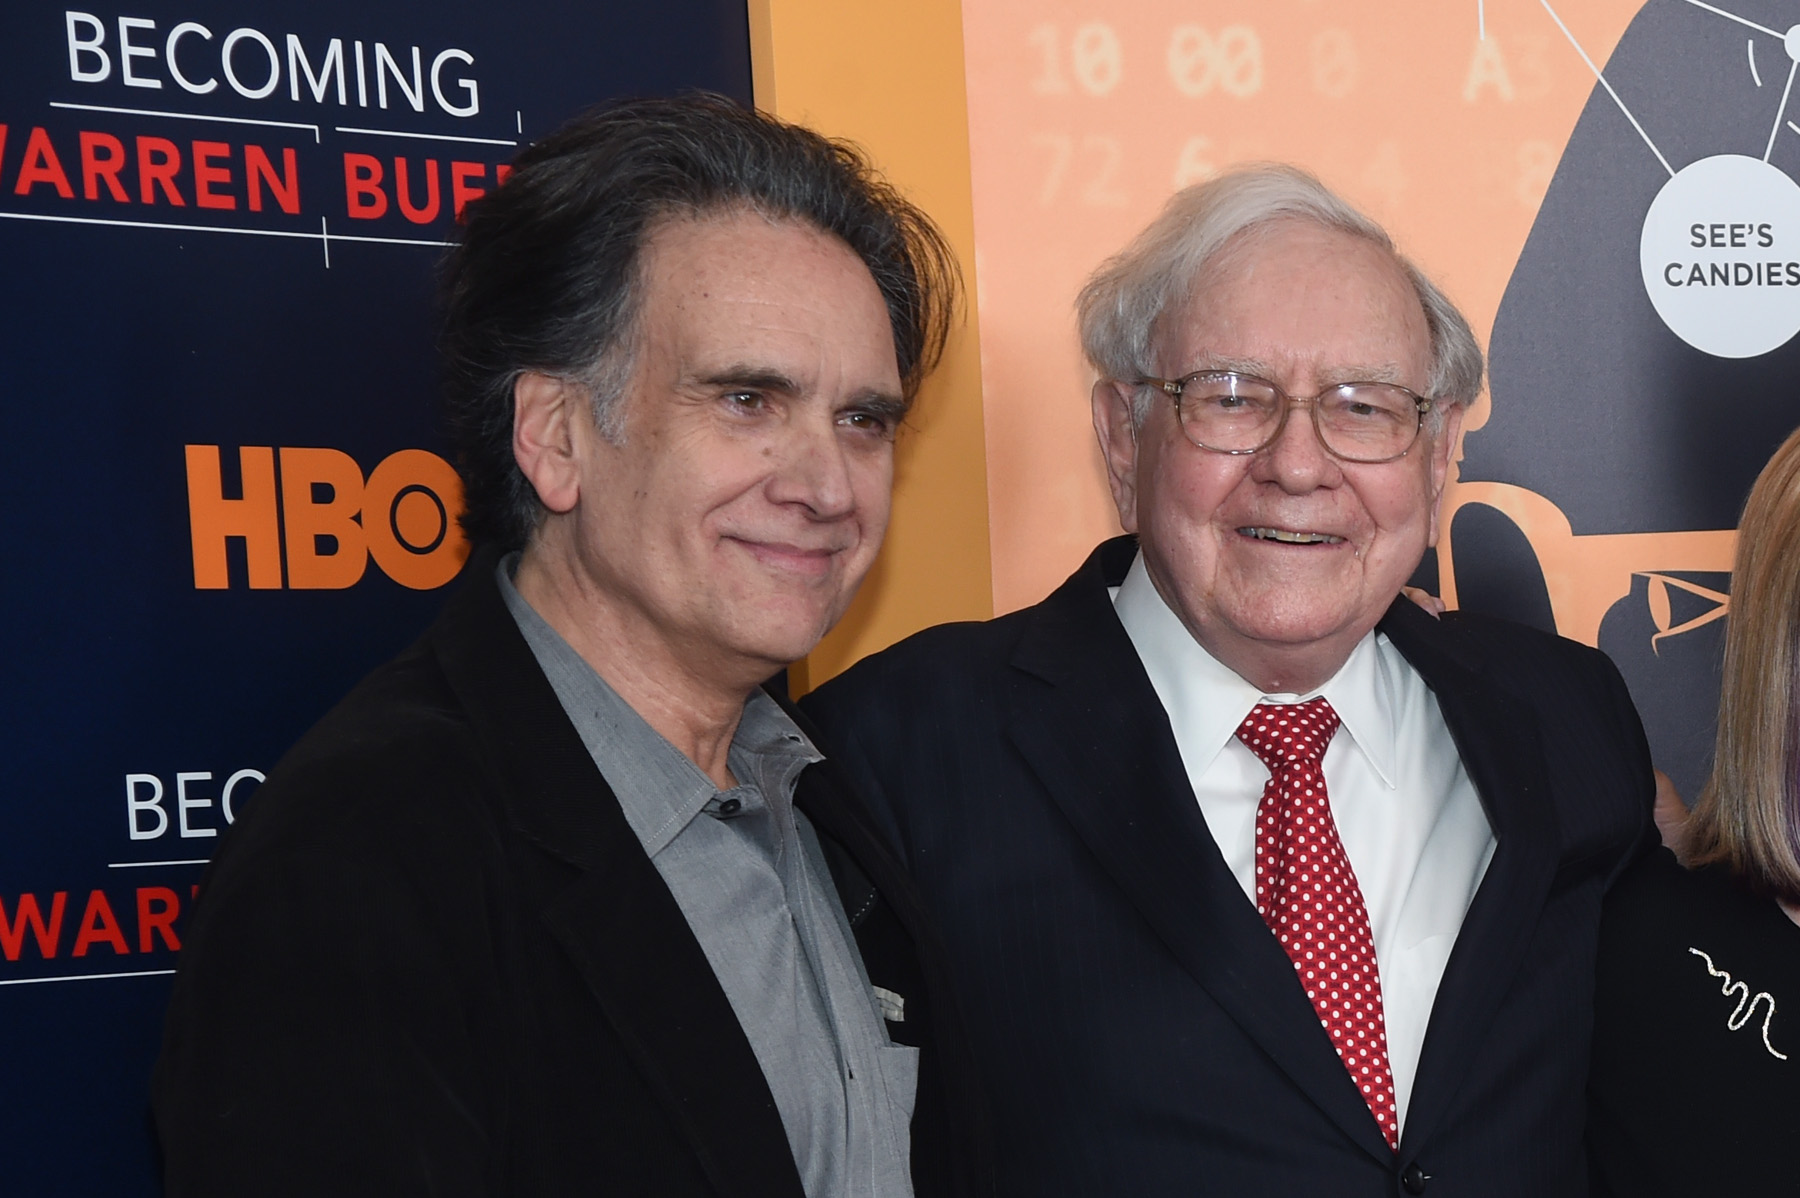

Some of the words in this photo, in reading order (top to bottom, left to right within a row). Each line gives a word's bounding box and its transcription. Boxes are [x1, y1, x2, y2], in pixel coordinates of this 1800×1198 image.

[65, 11, 480, 118] BECOMING
[344, 152, 516, 226] BUF
[1689, 223, 1775, 249] SEE'S
[185, 444, 471, 591] HBO
[0, 885, 199, 961] WAR
